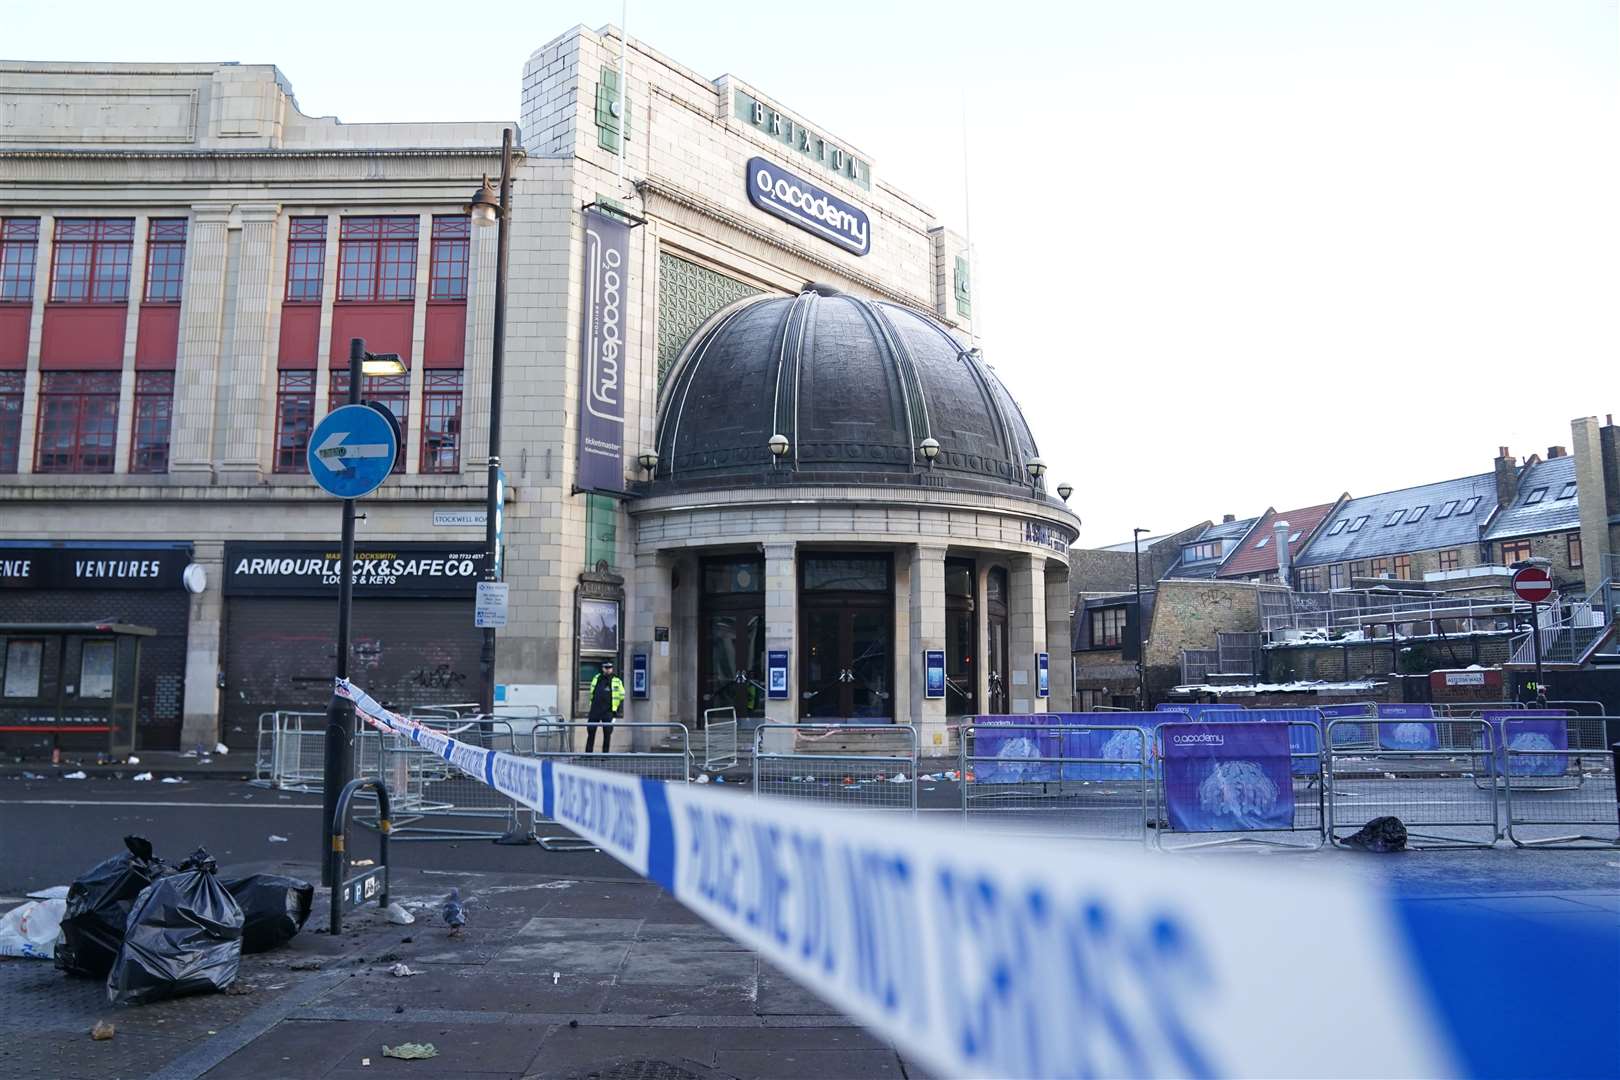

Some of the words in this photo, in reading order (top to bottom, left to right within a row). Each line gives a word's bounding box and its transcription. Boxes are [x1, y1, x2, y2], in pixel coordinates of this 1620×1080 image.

[752, 100, 860, 180] BRIXTON
[355, 552, 397, 560] LOCKSMITH
[75, 561, 160, 577] VENTURES
[323, 575, 358, 585] LOS
[360, 575, 367, 585] &
[369, 575, 397, 585] KEYS
